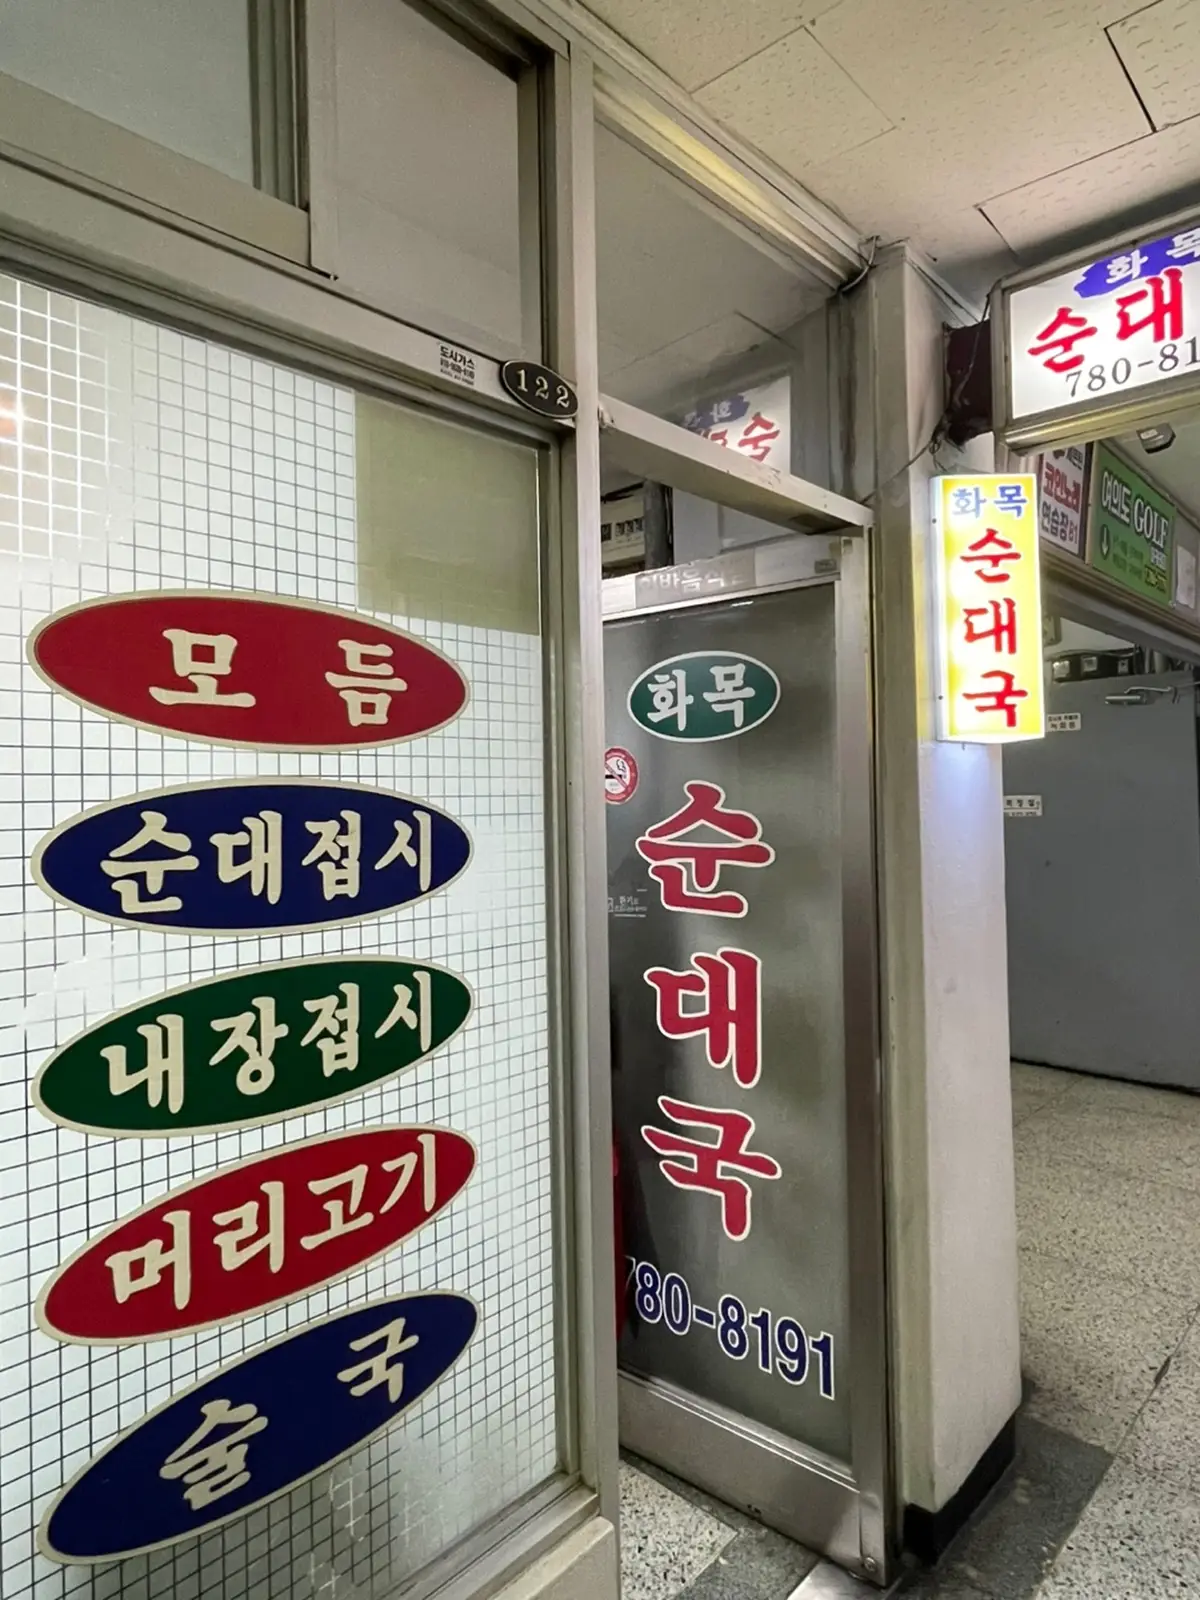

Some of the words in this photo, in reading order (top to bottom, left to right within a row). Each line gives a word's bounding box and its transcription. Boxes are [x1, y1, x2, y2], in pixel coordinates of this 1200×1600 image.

[439, 345, 476, 371] 도시가스
[515, 369, 570, 408] 122
[952, 485, 1027, 518] 화목
[1133, 498, 1169, 550] GOLF
[960, 528, 1028, 728] 순대국
[647, 663, 756, 731] 화목
[100, 810, 432, 914] 순대접시
[100, 971, 432, 1114] 내장접시
[636, 780, 782, 1241] 순대국
[105, 1133, 436, 1310] 머리고기
